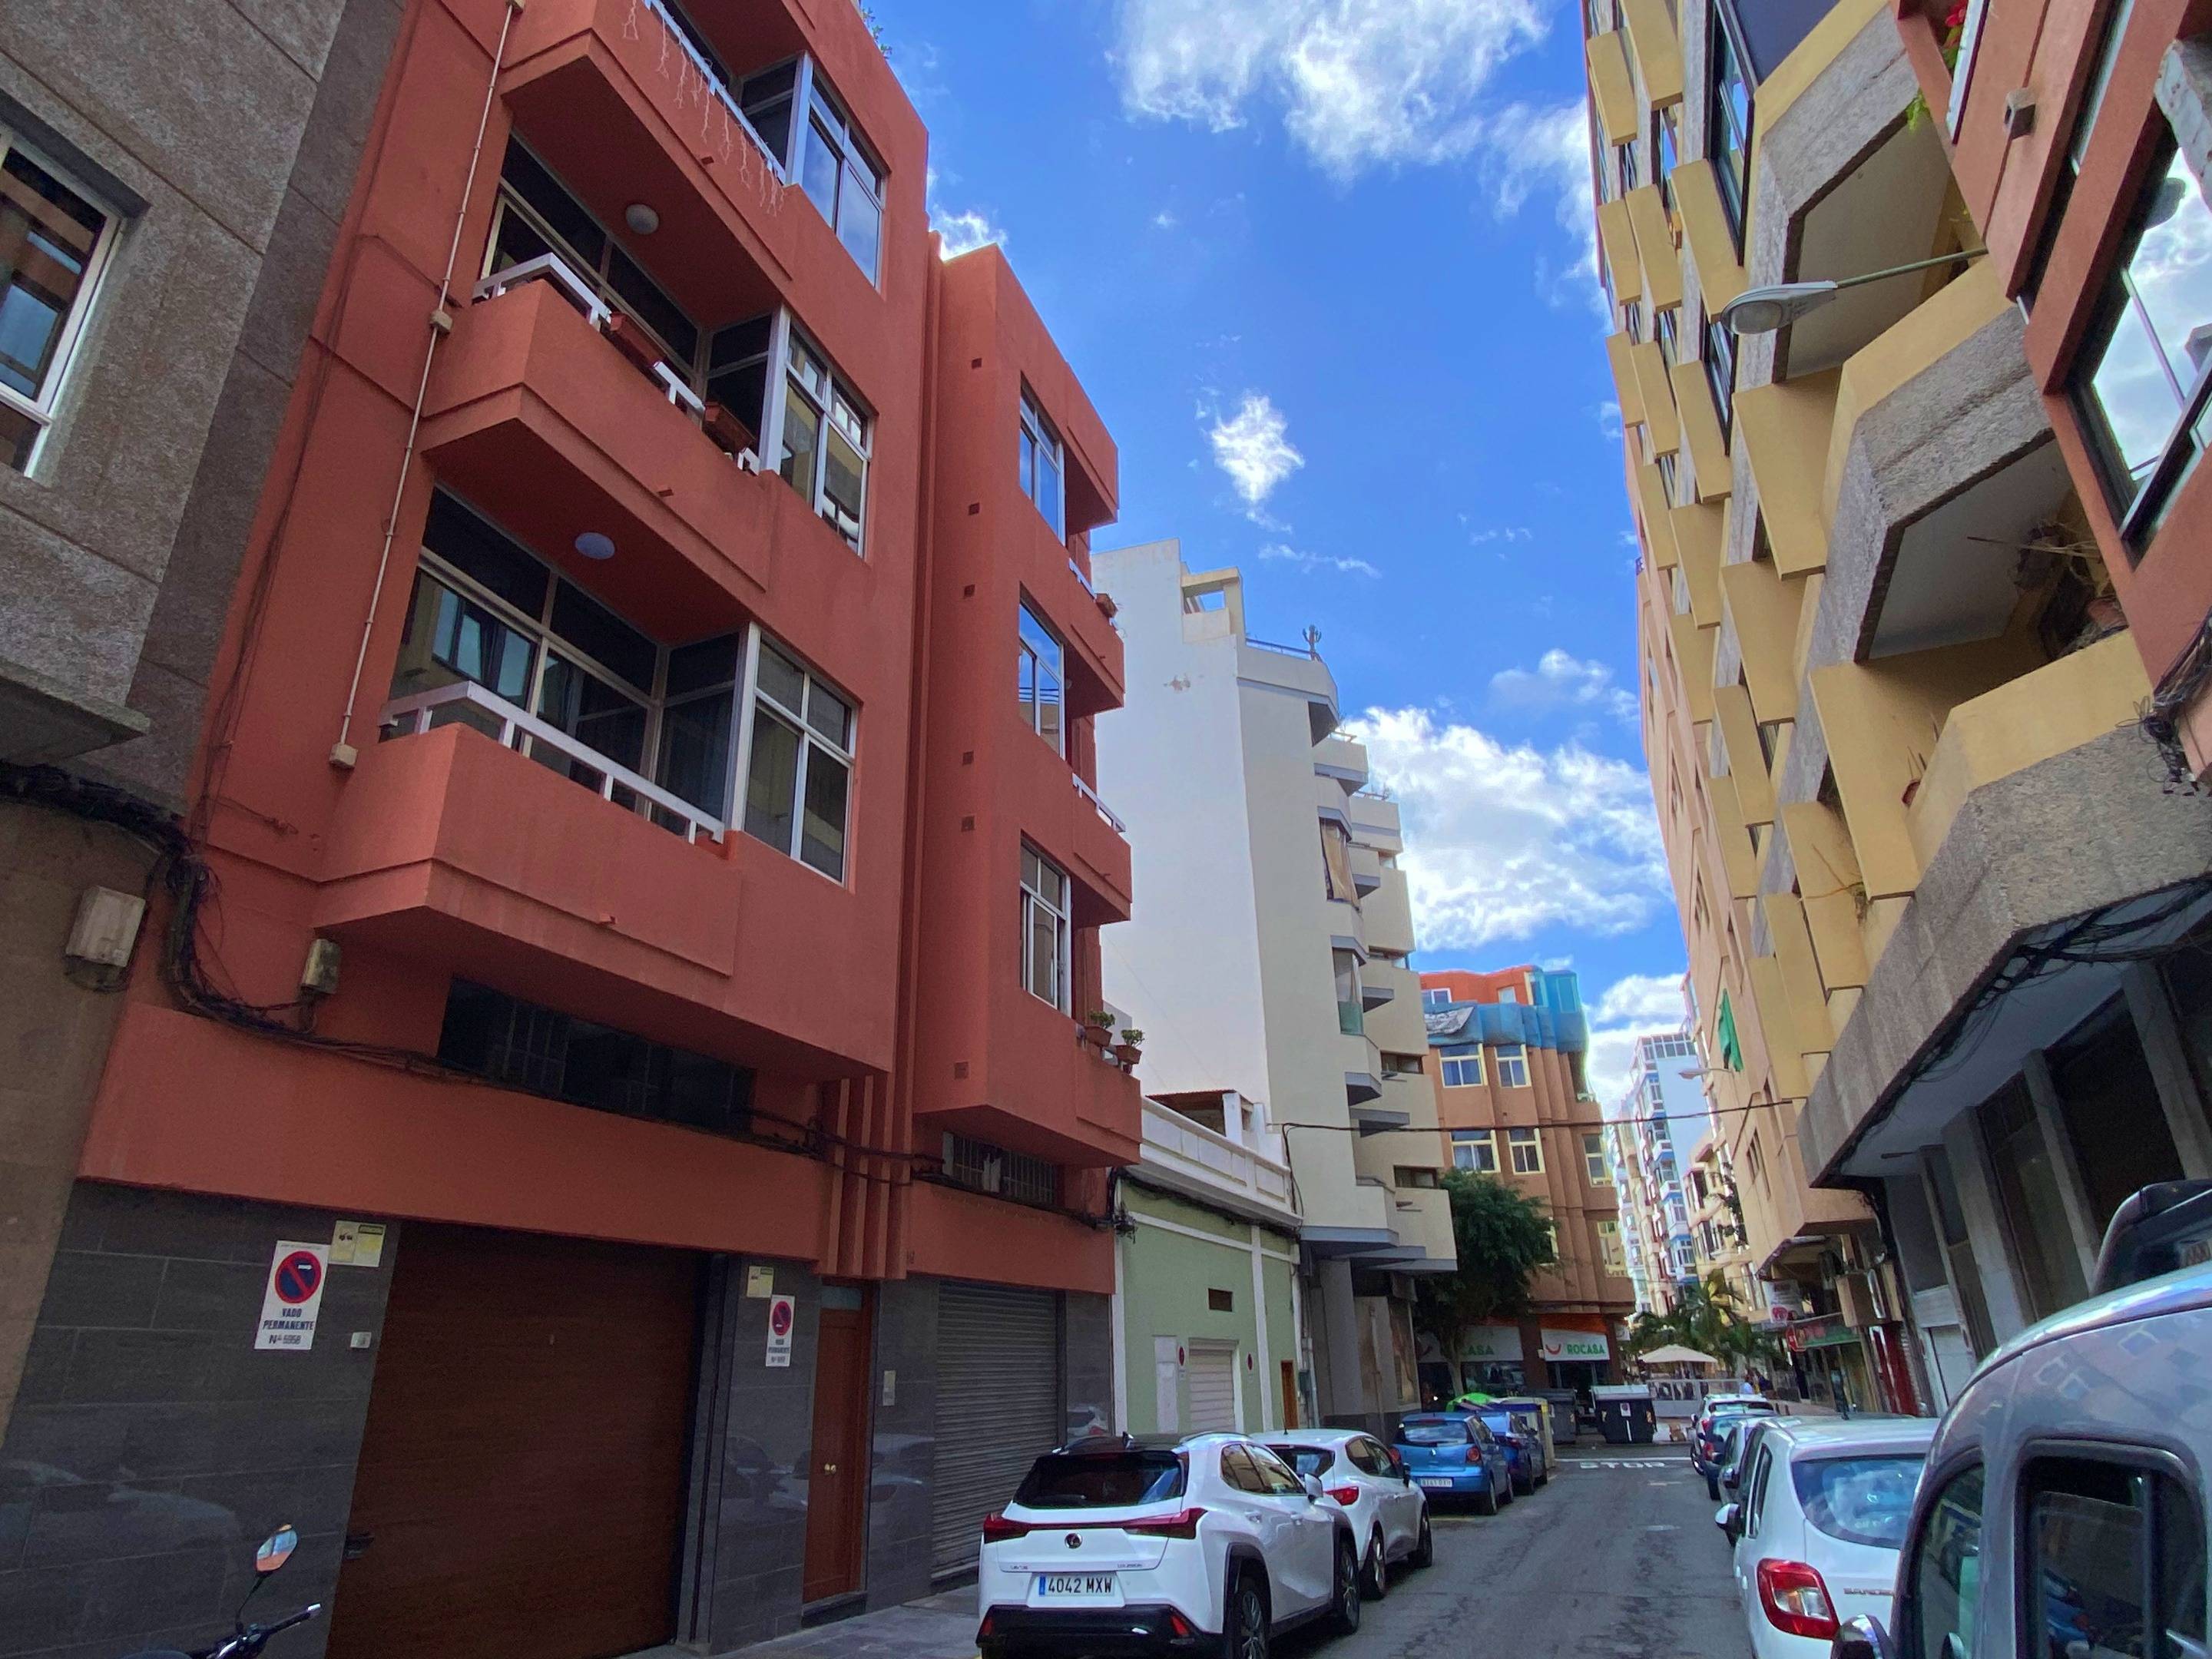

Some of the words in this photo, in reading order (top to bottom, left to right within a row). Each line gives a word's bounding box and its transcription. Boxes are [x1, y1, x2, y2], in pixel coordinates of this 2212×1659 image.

[282, 1308, 302, 1317] VADO
[263, 1320, 314, 1330] PERMANENTE
[1566, 1343, 1605, 1356] ROCASA
[1048, 1578, 1081, 1593] 4042
[1086, 1578, 1112, 1593] MXW
